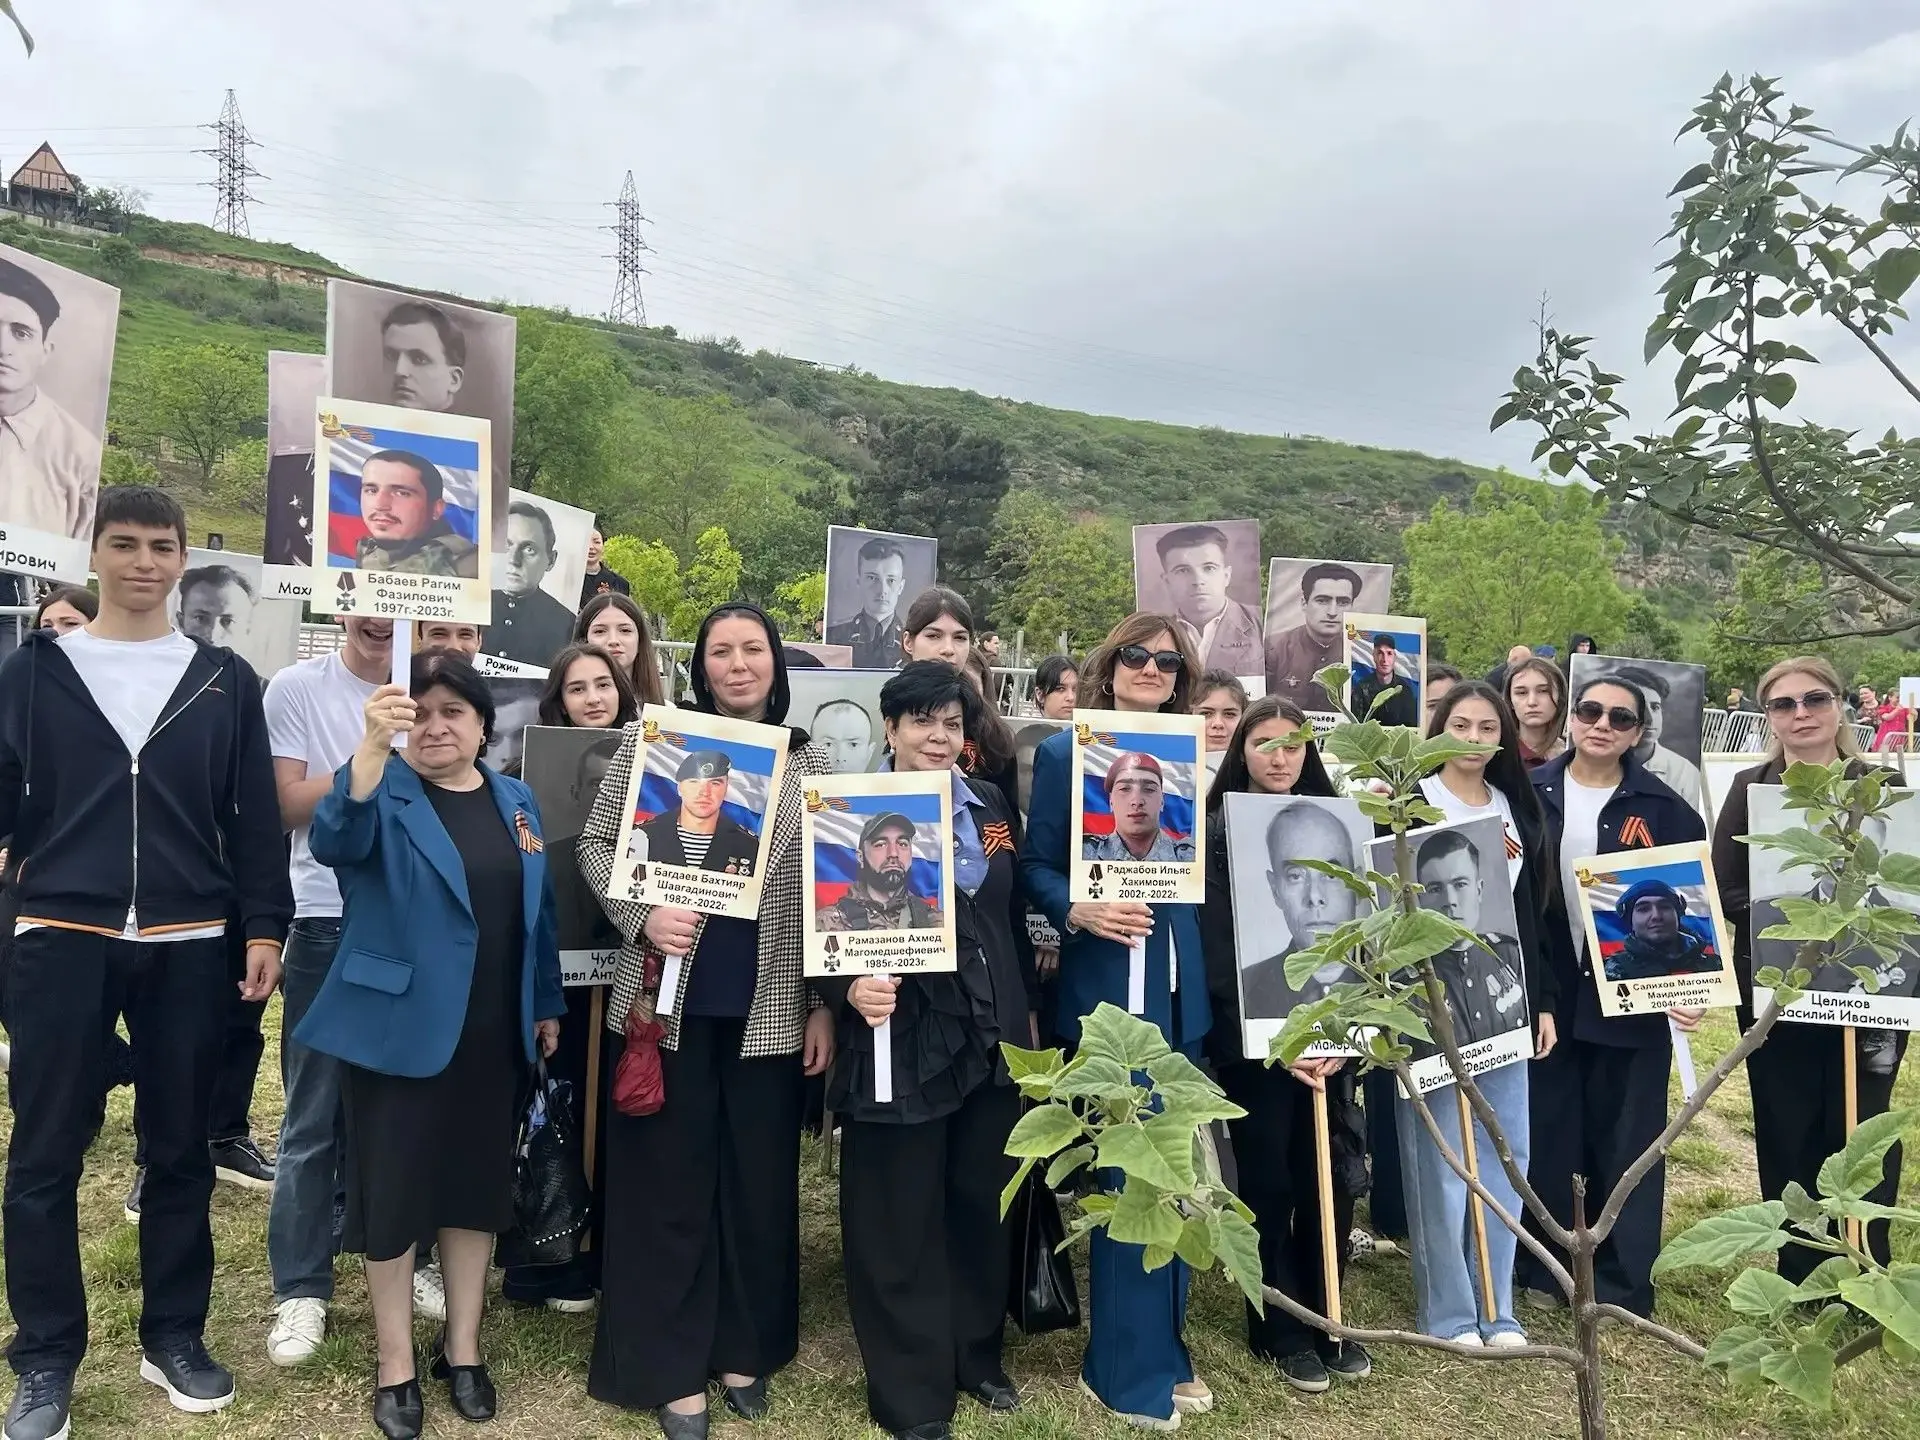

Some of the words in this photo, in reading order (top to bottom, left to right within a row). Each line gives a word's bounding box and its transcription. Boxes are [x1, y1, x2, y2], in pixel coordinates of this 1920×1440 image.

[278, 581, 312, 596] Мах
[368, 573, 417, 587] Бабаев
[421, 577, 462, 591] Рагим
[376, 588, 453, 604] Фазилович
[374, 602, 455, 618] 1997г.-2023г.
[485, 657, 519, 674] Рожин
[1107, 864, 1157, 875] Раджабов
[1159, 865, 1191, 875] Ильяс
[654, 867, 698, 882] Багдаев
[701, 874, 746, 891] Бахтияр
[1121, 877, 1177, 887] Хакимович
[657, 879, 738, 900] Шавгадинович
[1118, 889, 1179, 899] 2002г.-2022г.
[663, 893, 728, 911] 1982г.-2022г.
[848, 935, 905, 945] Рамазанов
[908, 934, 942, 943] Ахмед
[844, 946, 946, 957] Магомедшефиевич
[864, 958, 927, 968] 1985г.-2023г.
[560, 972, 586, 981] вел
[1632, 981, 1676, 991] Салихов
[1677, 976, 1722, 987] Магомед
[1811, 993, 1871, 1009] Целиков
[1840, 1009, 1910, 1027] Иванович
[1439, 1043, 1493, 1068] Пходько
